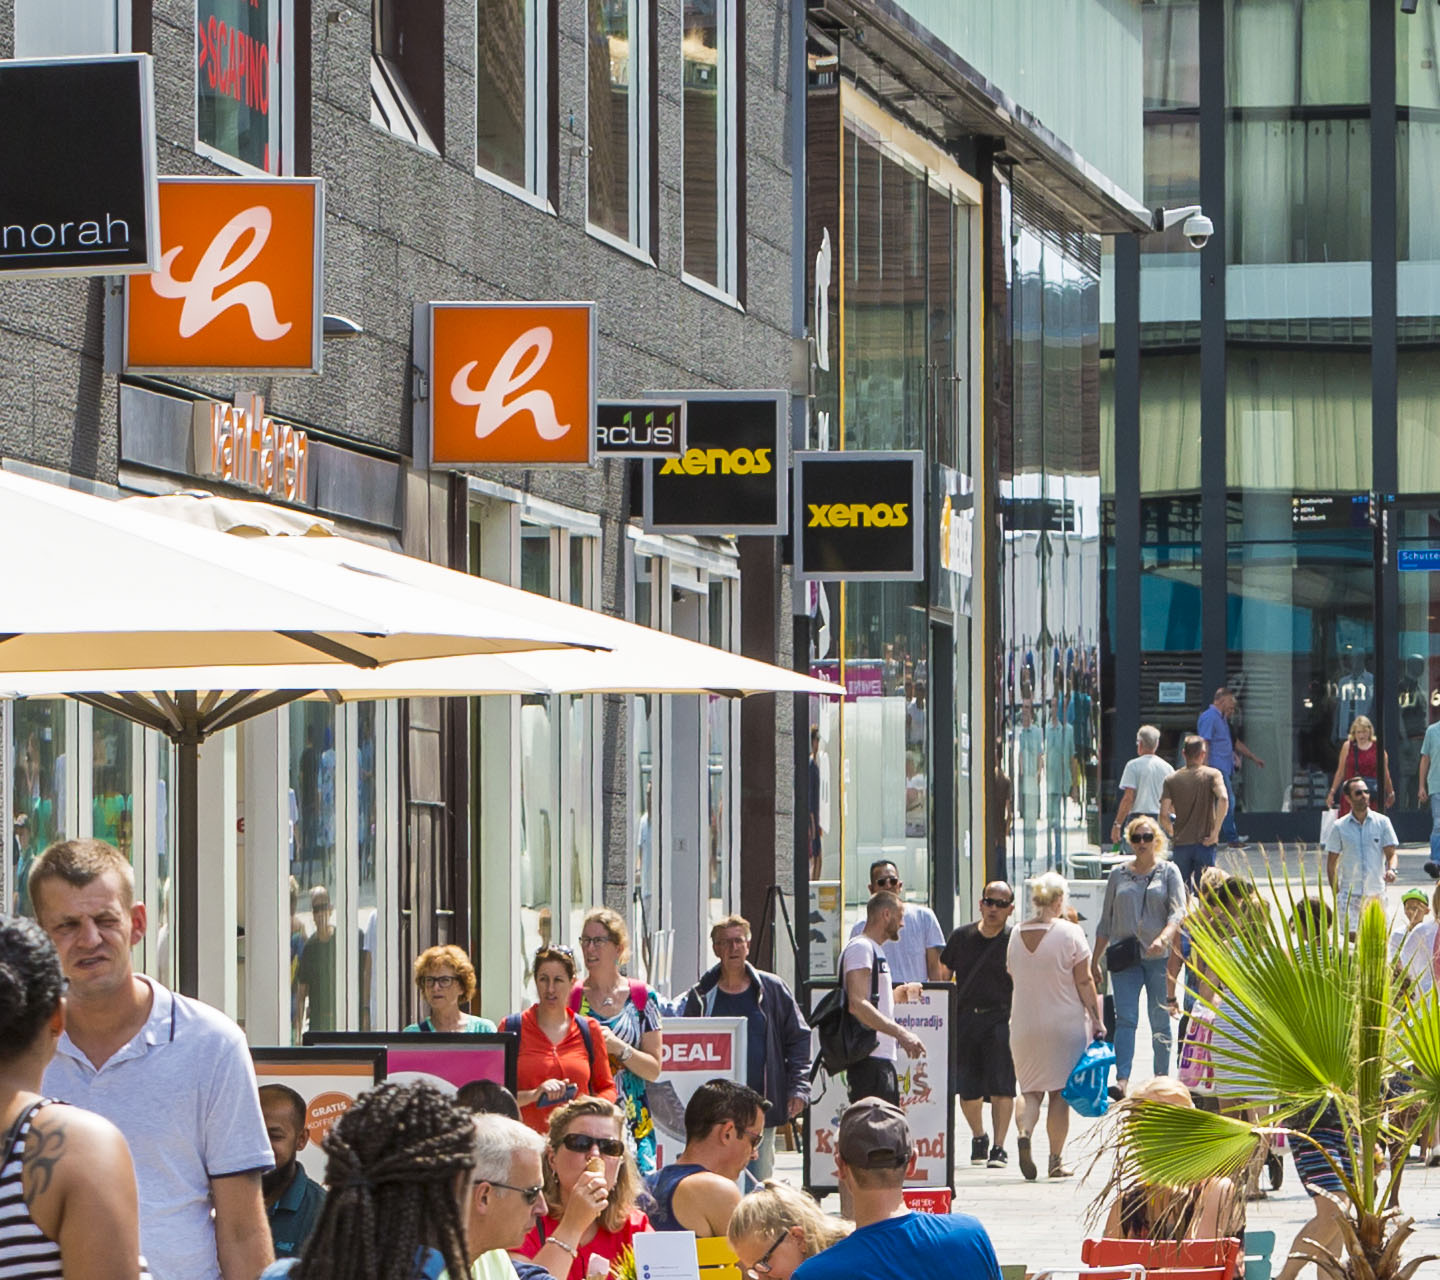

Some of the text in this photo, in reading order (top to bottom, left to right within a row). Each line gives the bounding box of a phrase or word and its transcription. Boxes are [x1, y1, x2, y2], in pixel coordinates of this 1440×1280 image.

[3, 213, 130, 249] norah
[659, 447, 771, 475] xenos
[807, 502, 909, 528] xenos
[311, 1101, 348, 1118] GRATIS
